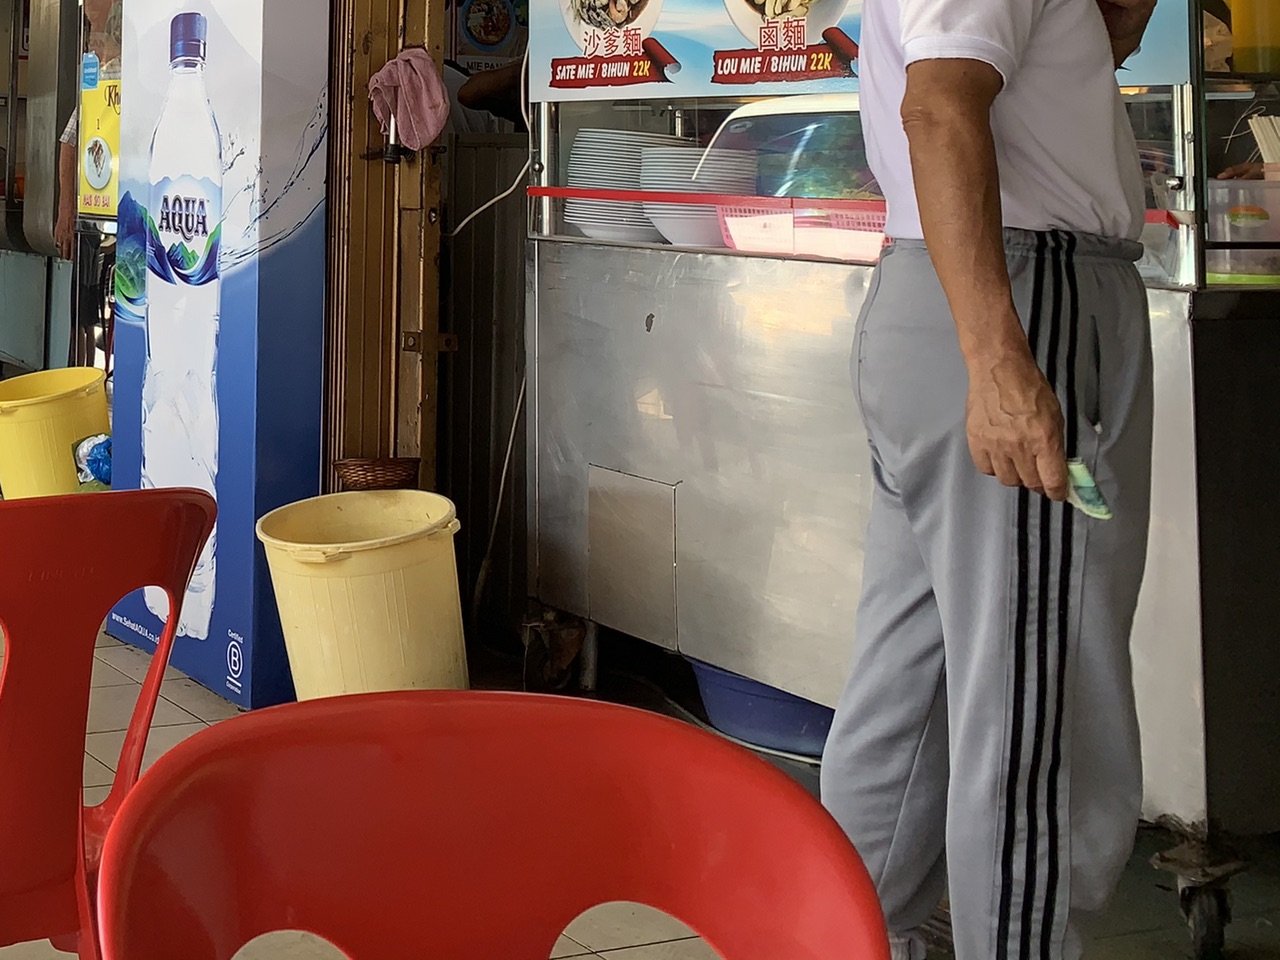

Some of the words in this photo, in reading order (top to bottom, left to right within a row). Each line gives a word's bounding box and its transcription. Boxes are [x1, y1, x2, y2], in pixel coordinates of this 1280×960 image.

[555, 64, 576, 80] SATE
[577, 63, 596, 79] MIE
[601, 62, 631, 78] BIHUN
[633, 60, 651, 77] 22K
[717, 57, 738, 75] LOU
[739, 56, 763, 74] MIE
[770, 54, 808, 73] BIHUN
[810, 52, 833, 71] 22K
[158, 194, 208, 243] AQUA
